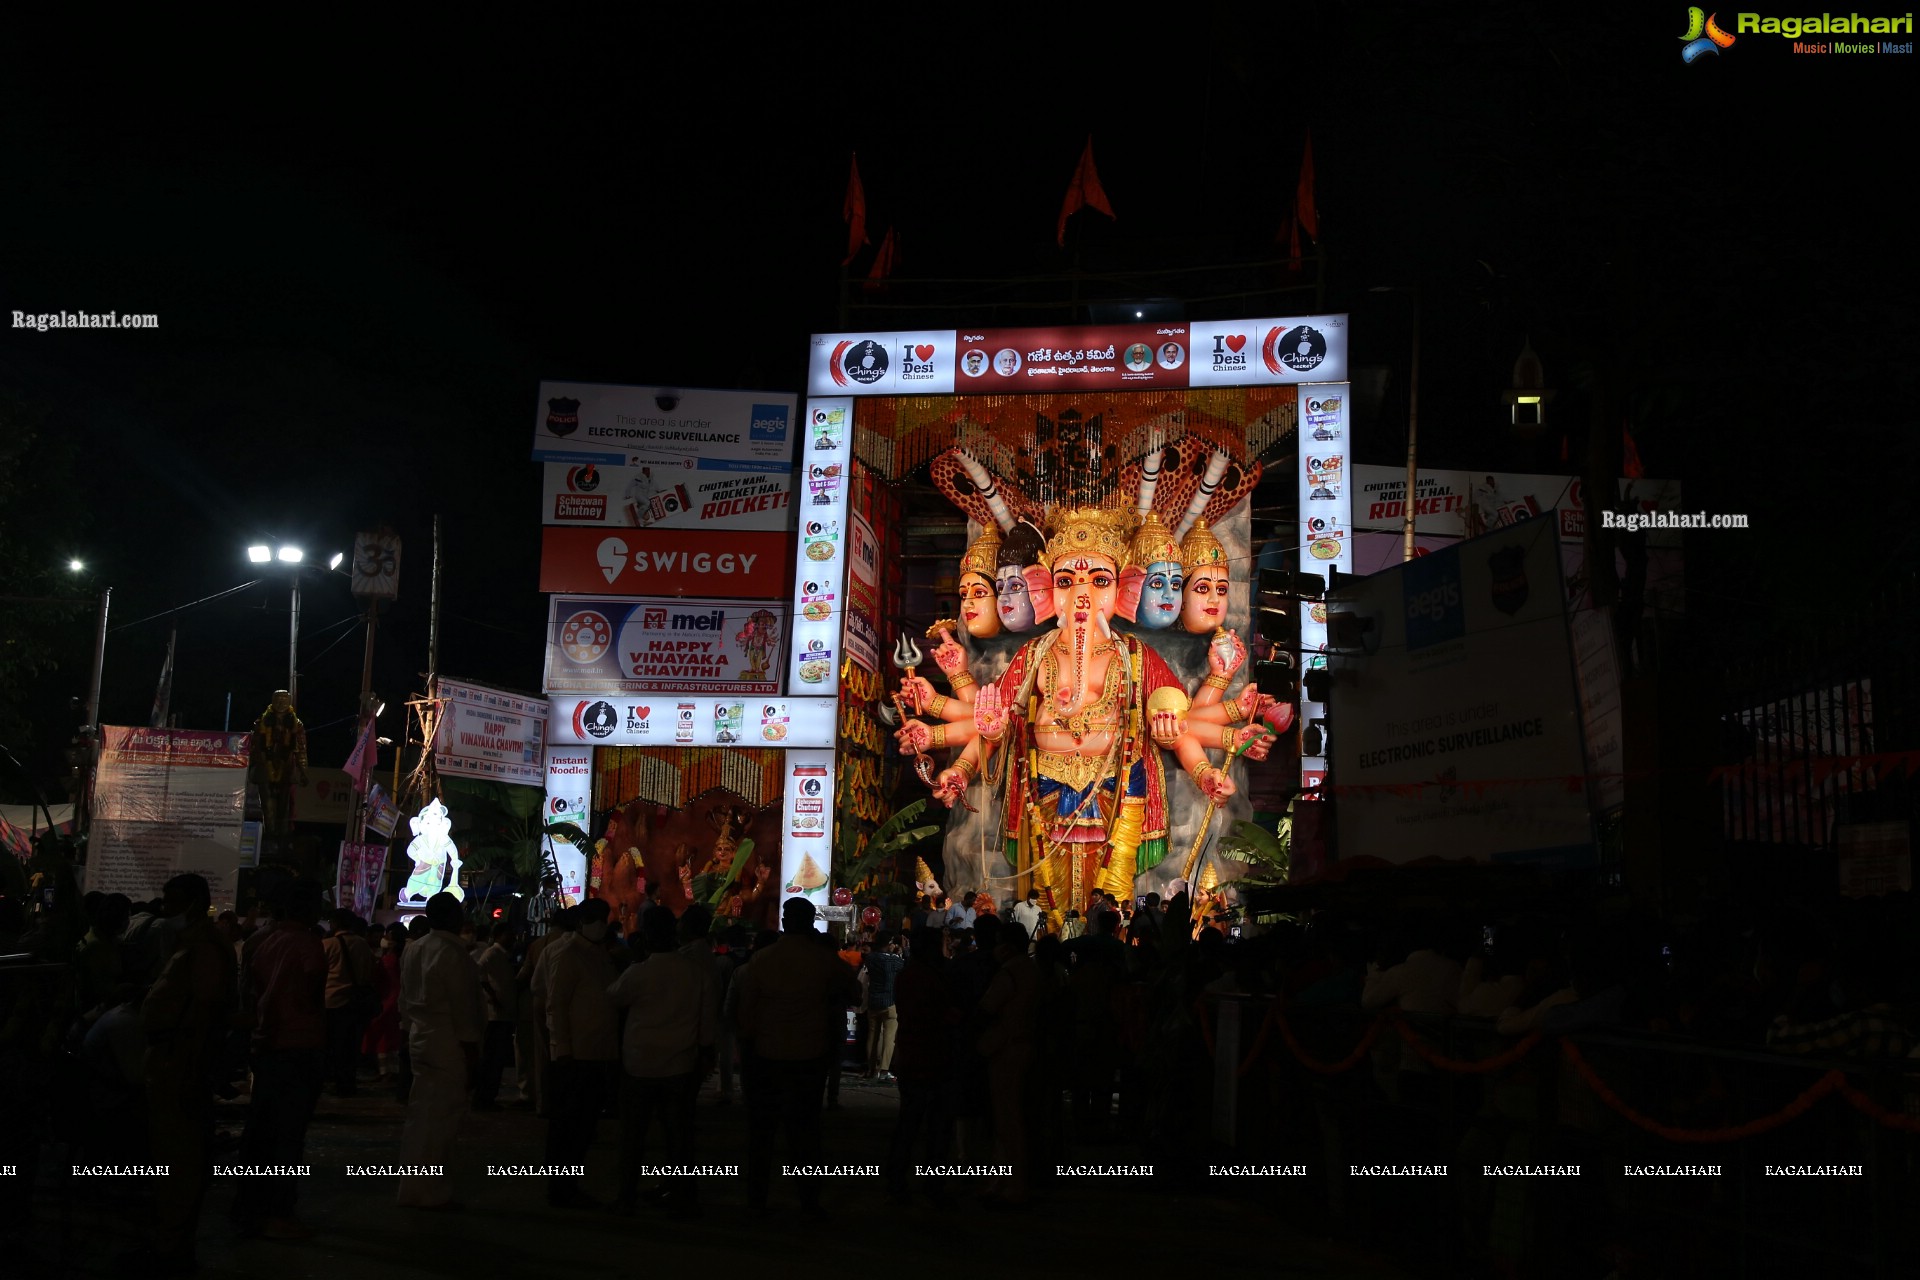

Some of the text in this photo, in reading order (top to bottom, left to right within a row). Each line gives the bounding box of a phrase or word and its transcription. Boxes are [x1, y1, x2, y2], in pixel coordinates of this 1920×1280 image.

[1213, 335, 1224, 353] I
[903, 344, 914, 362] I
[1212, 352, 1246, 365] Desi
[1281, 353, 1323, 365] Ching's
[847, 365, 886, 378] Ching's
[902, 361, 934, 374] Desi
[1212, 364, 1246, 372] Chinese
[616, 414, 712, 429] This area is under
[753, 416, 785, 433] aegis
[588, 426, 741, 444] ELECTRONIC SURVEILLANCE
[699, 475, 767, 493] CHUTNEY NAHI.
[1428, 486, 1453, 497] HAI.
[712, 482, 782, 502] ROCKET HAI.
[559, 495, 603, 506] Schezwan
[700, 491, 791, 520] ROCKET!
[558, 504, 603, 519] Chutney
[633, 551, 757, 574] SWIGGY
[1407, 575, 1460, 622] aegis
[671, 611, 725, 631] meil
[648, 640, 713, 653] HAPPY
[629, 652, 729, 665] VINAYAKA
[632, 665, 721, 677] CHAVITHI
[652, 682, 658, 690] &
[661, 682, 752, 692] INFRASTRUCTURES
[755, 684, 775, 692] LTD.
[626, 720, 650, 729] Desi
[1386, 702, 1500, 739] This area is under
[484, 722, 506, 737] HAPPY
[460, 732, 524, 754] VINAYAKA CHAVITHI
[1359, 717, 1544, 770] ELECTRONIC SURVEILLANCE
[551, 756, 588, 765] Instant
[549, 766, 589, 775] Noodles
